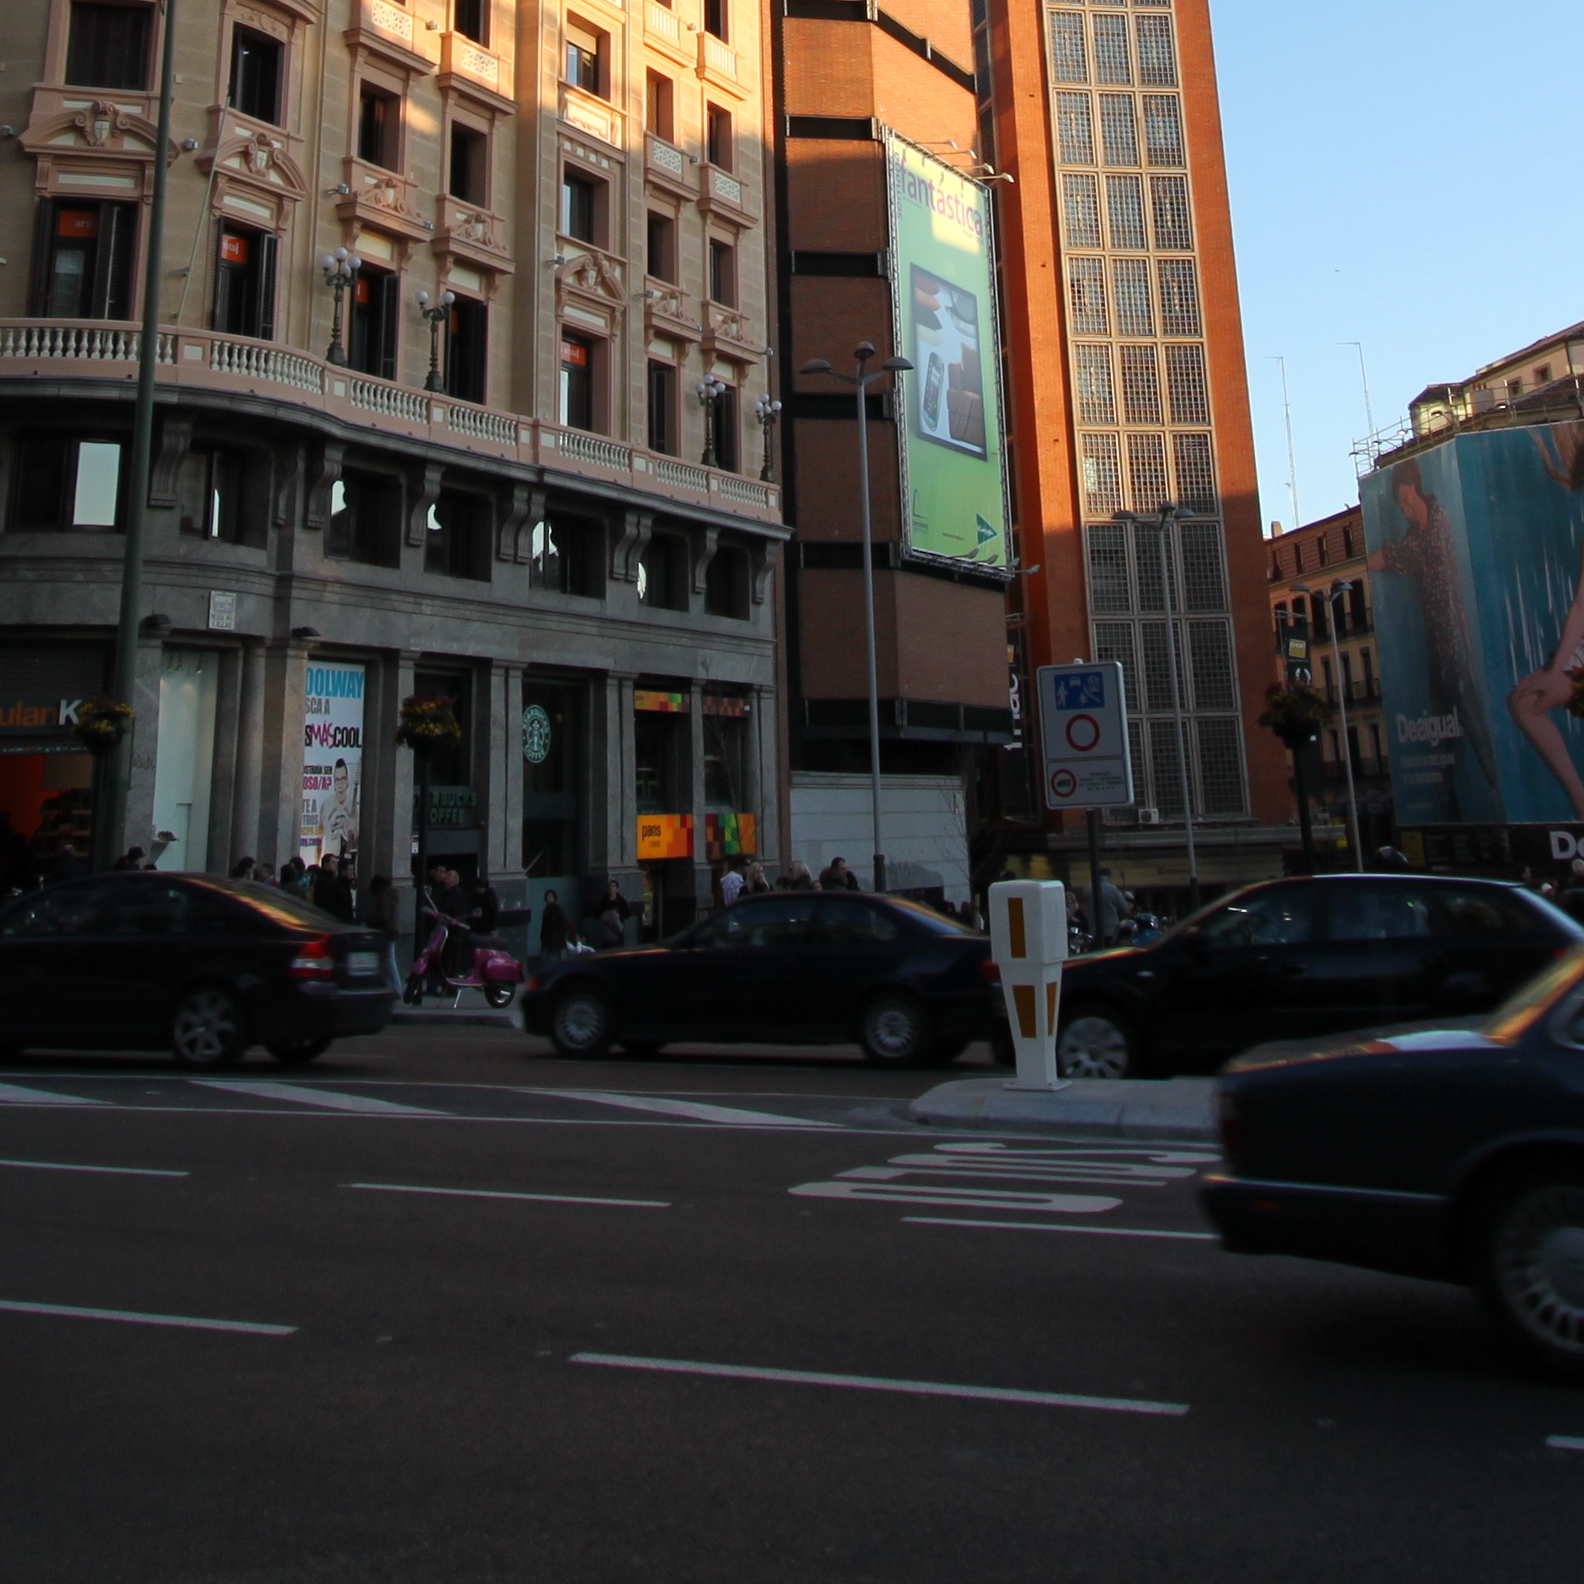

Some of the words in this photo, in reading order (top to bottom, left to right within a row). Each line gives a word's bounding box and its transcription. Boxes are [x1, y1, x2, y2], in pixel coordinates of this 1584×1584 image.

[899, 156, 983, 236] fantástica
[305, 668, 364, 699] OOLWAY
[334, 726, 363, 748] COOL
